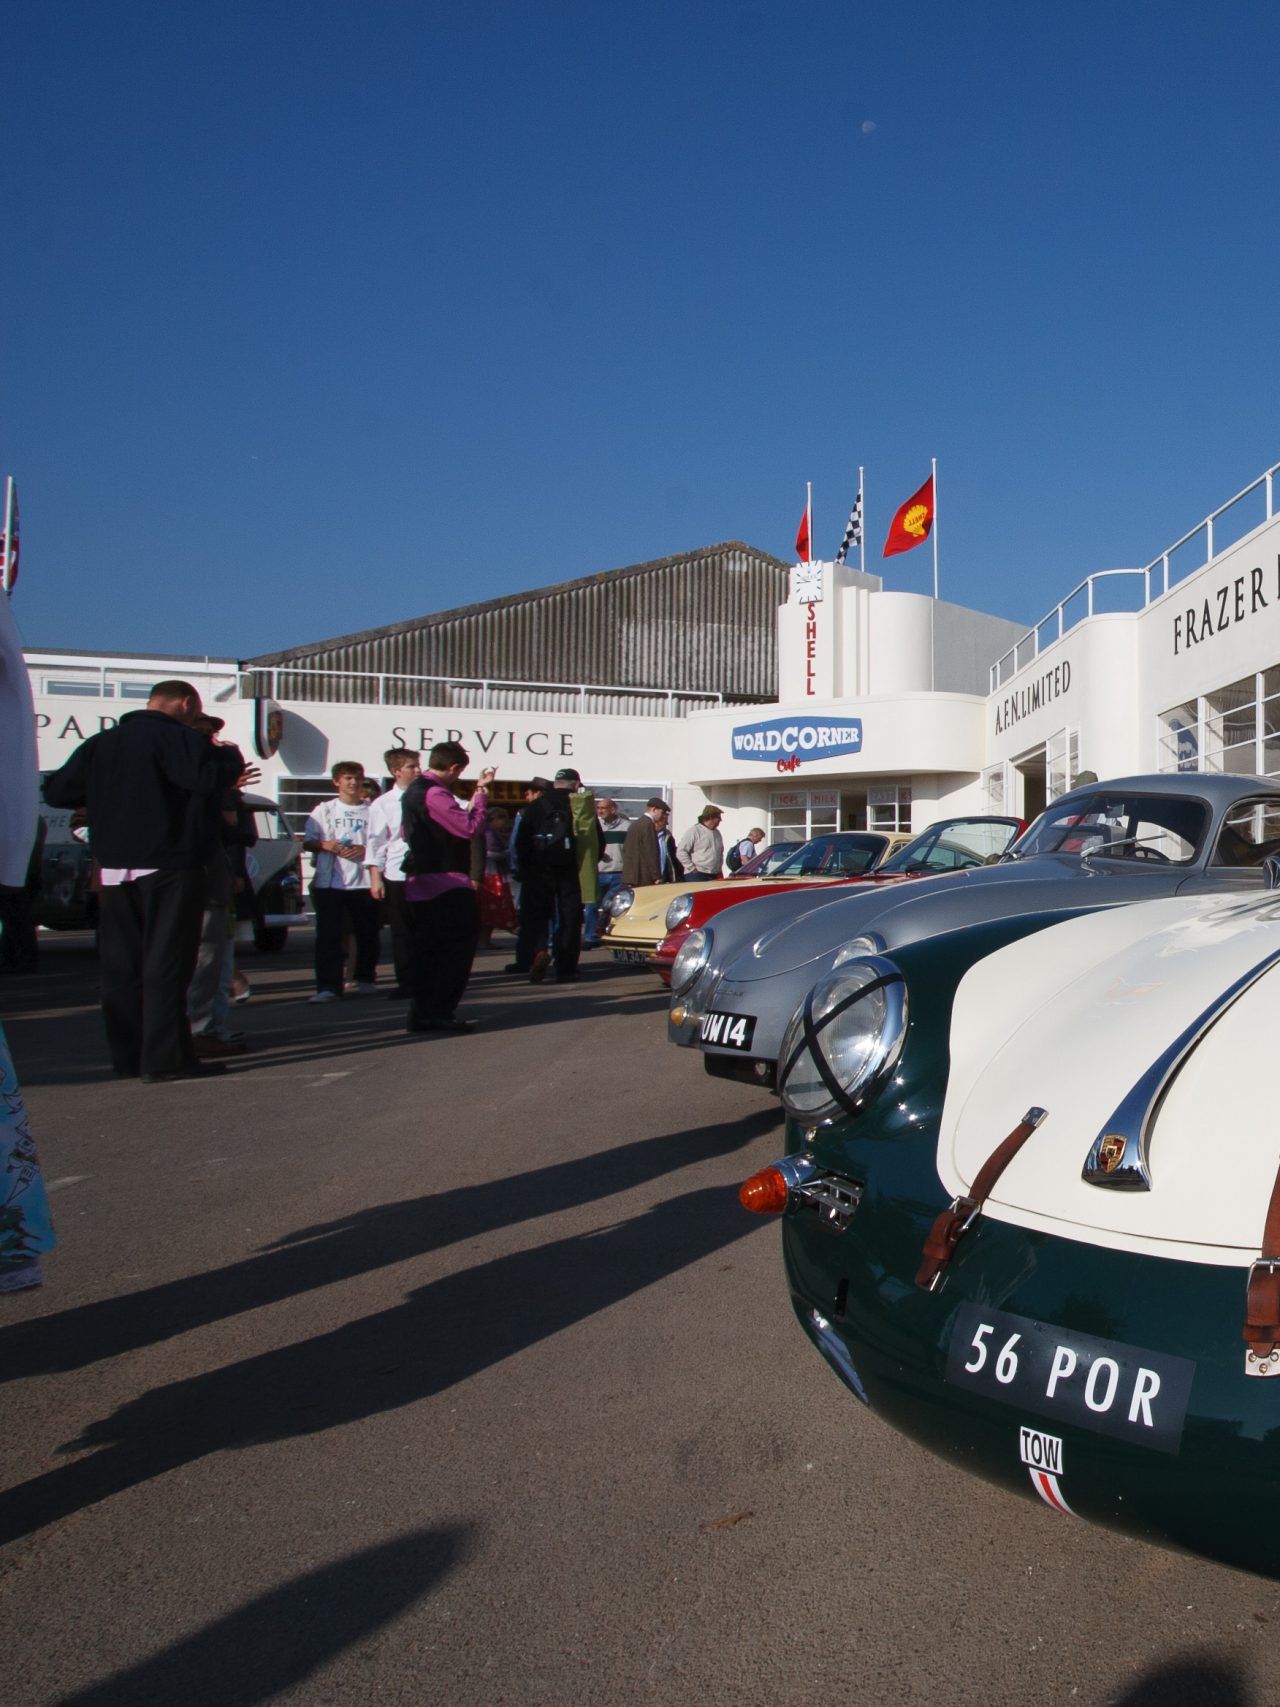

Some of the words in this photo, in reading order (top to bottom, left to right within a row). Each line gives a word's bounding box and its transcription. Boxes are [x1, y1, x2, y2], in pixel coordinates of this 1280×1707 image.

[1174, 567, 1269, 656] FRAZER
[806, 602, 817, 696] SHELL
[1021, 660, 1071, 718] LIMITED
[391, 727, 574, 756] SERVICE
[964, 1323, 1022, 1385] 56
[1045, 1345, 1161, 1428] POR
[1021, 1430, 1060, 1471] TOW
